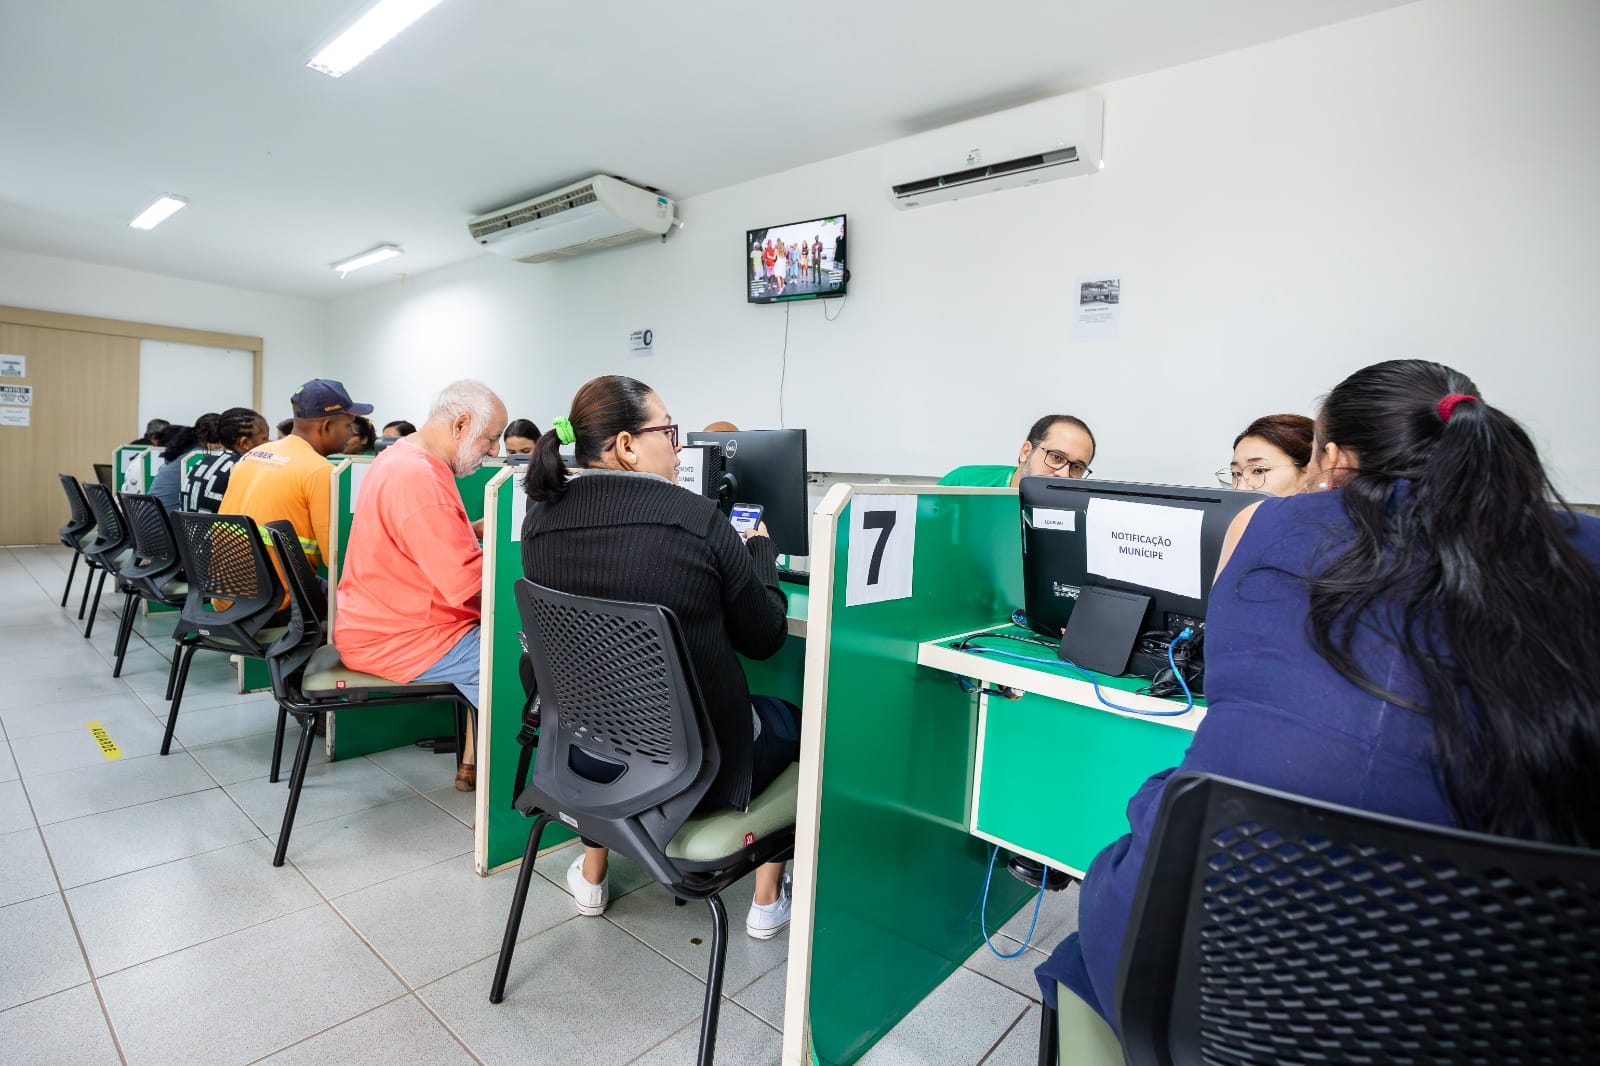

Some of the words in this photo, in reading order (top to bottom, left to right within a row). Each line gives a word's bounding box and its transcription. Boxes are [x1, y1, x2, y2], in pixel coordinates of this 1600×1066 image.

[863, 511, 896, 586] 7
[1111, 531, 1172, 547] NOTIFICAÇÃO
[1119, 546, 1164, 560] MUNÍCIPE
[90, 728, 117, 752] AGUARDE
